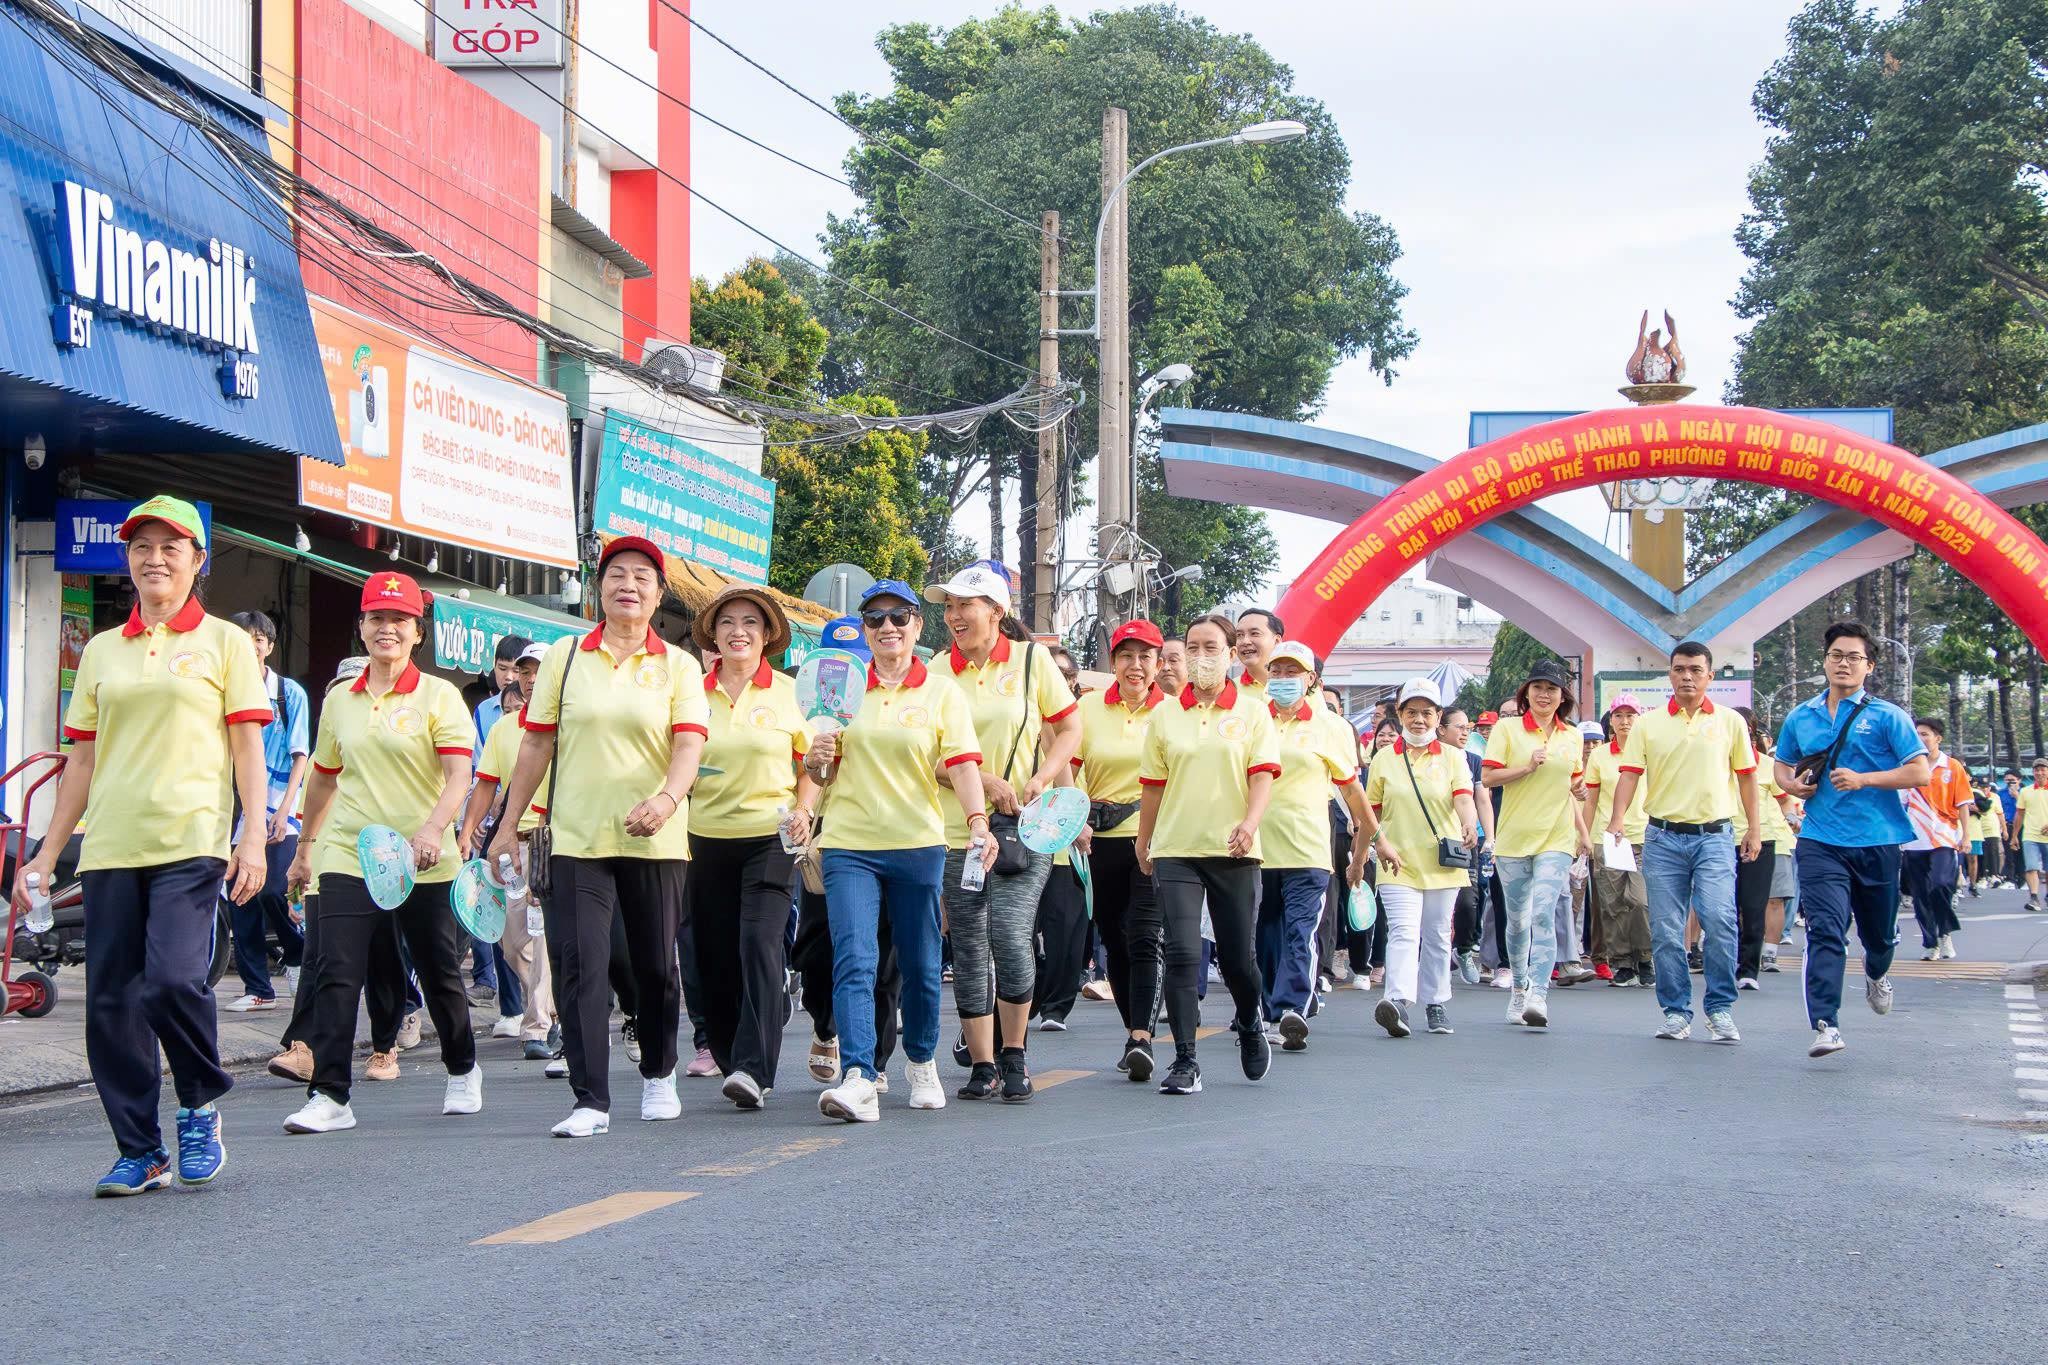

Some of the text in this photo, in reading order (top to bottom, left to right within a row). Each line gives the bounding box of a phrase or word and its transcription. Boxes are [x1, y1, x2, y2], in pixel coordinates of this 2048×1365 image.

[453, 22, 540, 54] GÓP
[65, 180, 260, 354] Vinamilk
[69, 304, 94, 349] EST
[234, 359, 260, 400] 1976
[413, 376, 433, 414] CÁ
[436, 384, 466, 426] VIÊN
[468, 400, 504, 437] DUNG
[514, 410, 539, 449] DÂN
[541, 421, 566, 457] CHỦ
[1314, 532, 1386, 601] CHƯƠNG
[1384, 489, 1446, 537] TRÌNH
[1445, 475, 1470, 500] ĐI
[1472, 456, 1503, 486] BỘ
[1508, 437, 1567, 473] ĐỒNG
[1573, 423, 1632, 453] HÀNH
[1640, 419, 1669, 443] VÀ
[1680, 418, 1737, 443] NGÀY
[1745, 424, 1783, 450] HỘI
[1789, 432, 1829, 460] ĐẠI
[1834, 443, 1894, 481] ĐOÀN
[1897, 468, 1940, 502] KẾT
[1943, 494, 1997, 540] TOÀN
[1397, 529, 1429, 559] ĐẠI
[1432, 508, 1463, 534] HỘI
[1467, 481, 1502, 515] THỂ
[1507, 471, 1544, 499] DỤC
[1551, 451, 1585, 481] THỂ
[1593, 450, 1640, 473] THAO
[1650, 444, 1727, 466] PHƯỜNG
[1737, 449, 1773, 471] THỦ
[1779, 456, 1819, 481] ĐỨC
[1825, 469, 1865, 497] LẦN
[1883, 491, 1929, 527] NĂM
[1929, 519, 1976, 556] 2025
[72, 516, 129, 544] Vina
[72, 544, 85, 554] EST
[435, 614, 468, 663] NƯỚC
[470, 617, 485, 666] ÉP
